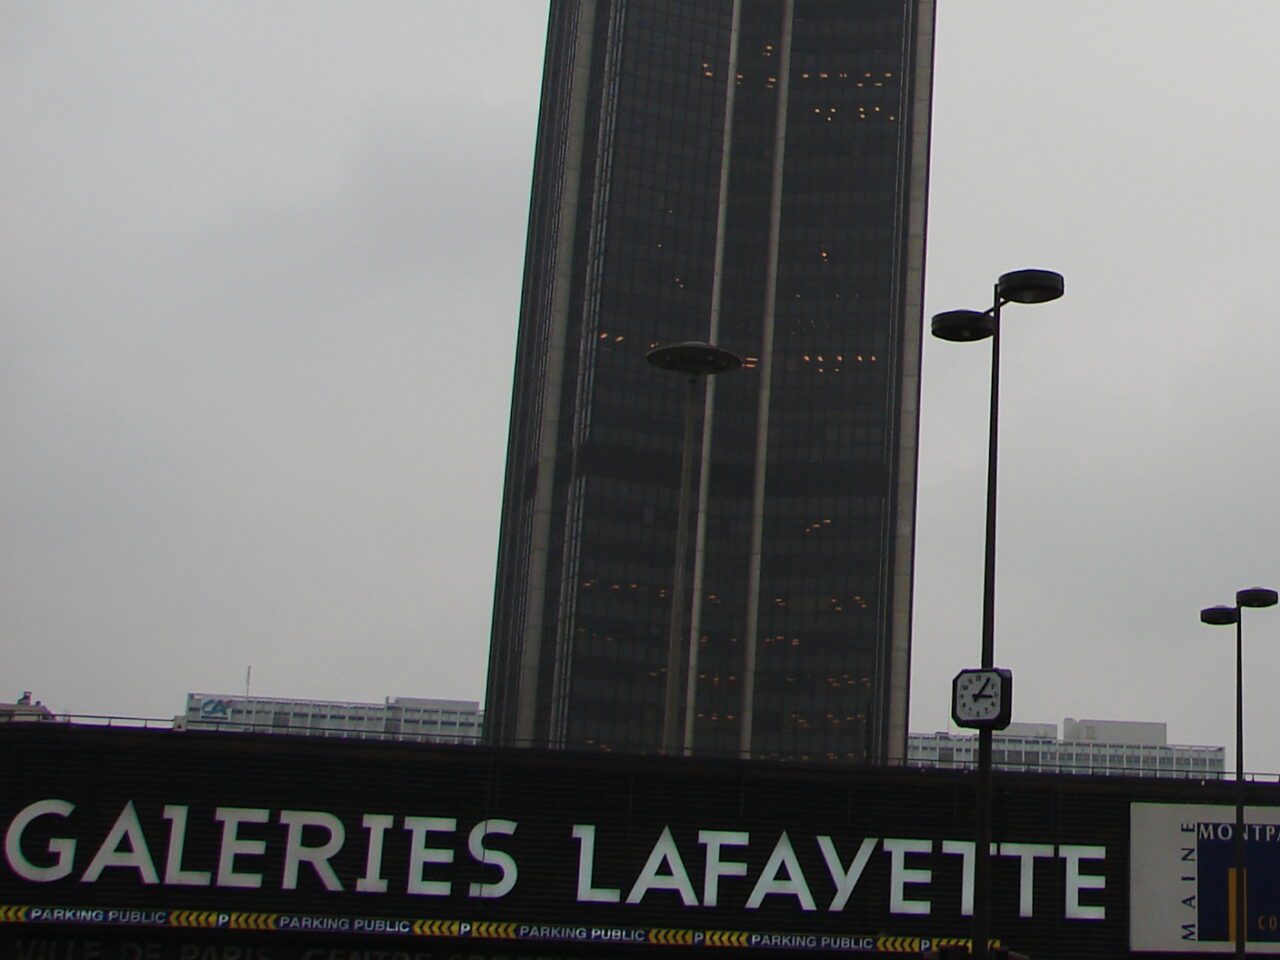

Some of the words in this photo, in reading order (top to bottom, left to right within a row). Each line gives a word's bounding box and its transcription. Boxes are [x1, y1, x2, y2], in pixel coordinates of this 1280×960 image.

[4, 798, 519, 899] GALERIES
[572, 823, 1107, 920] LAFAYETTE
[1181, 823, 1196, 941] MAINE
[30, 908, 103, 921] PARKING
[108, 910, 167, 924] PUBLIC
[218, 913, 229, 926] P
[279, 916, 349, 929] PARKING
[354, 918, 410, 932] PUBLIC
[460, 923, 471, 935] P
[519, 925, 587, 939] PARKING
[591, 929, 645, 942] PUBLIC
[693, 932, 704, 944] P
[751, 934, 817, 947] PARKING
[821, 936, 874, 949] PUBLIC
[921, 939, 931, 951] P
